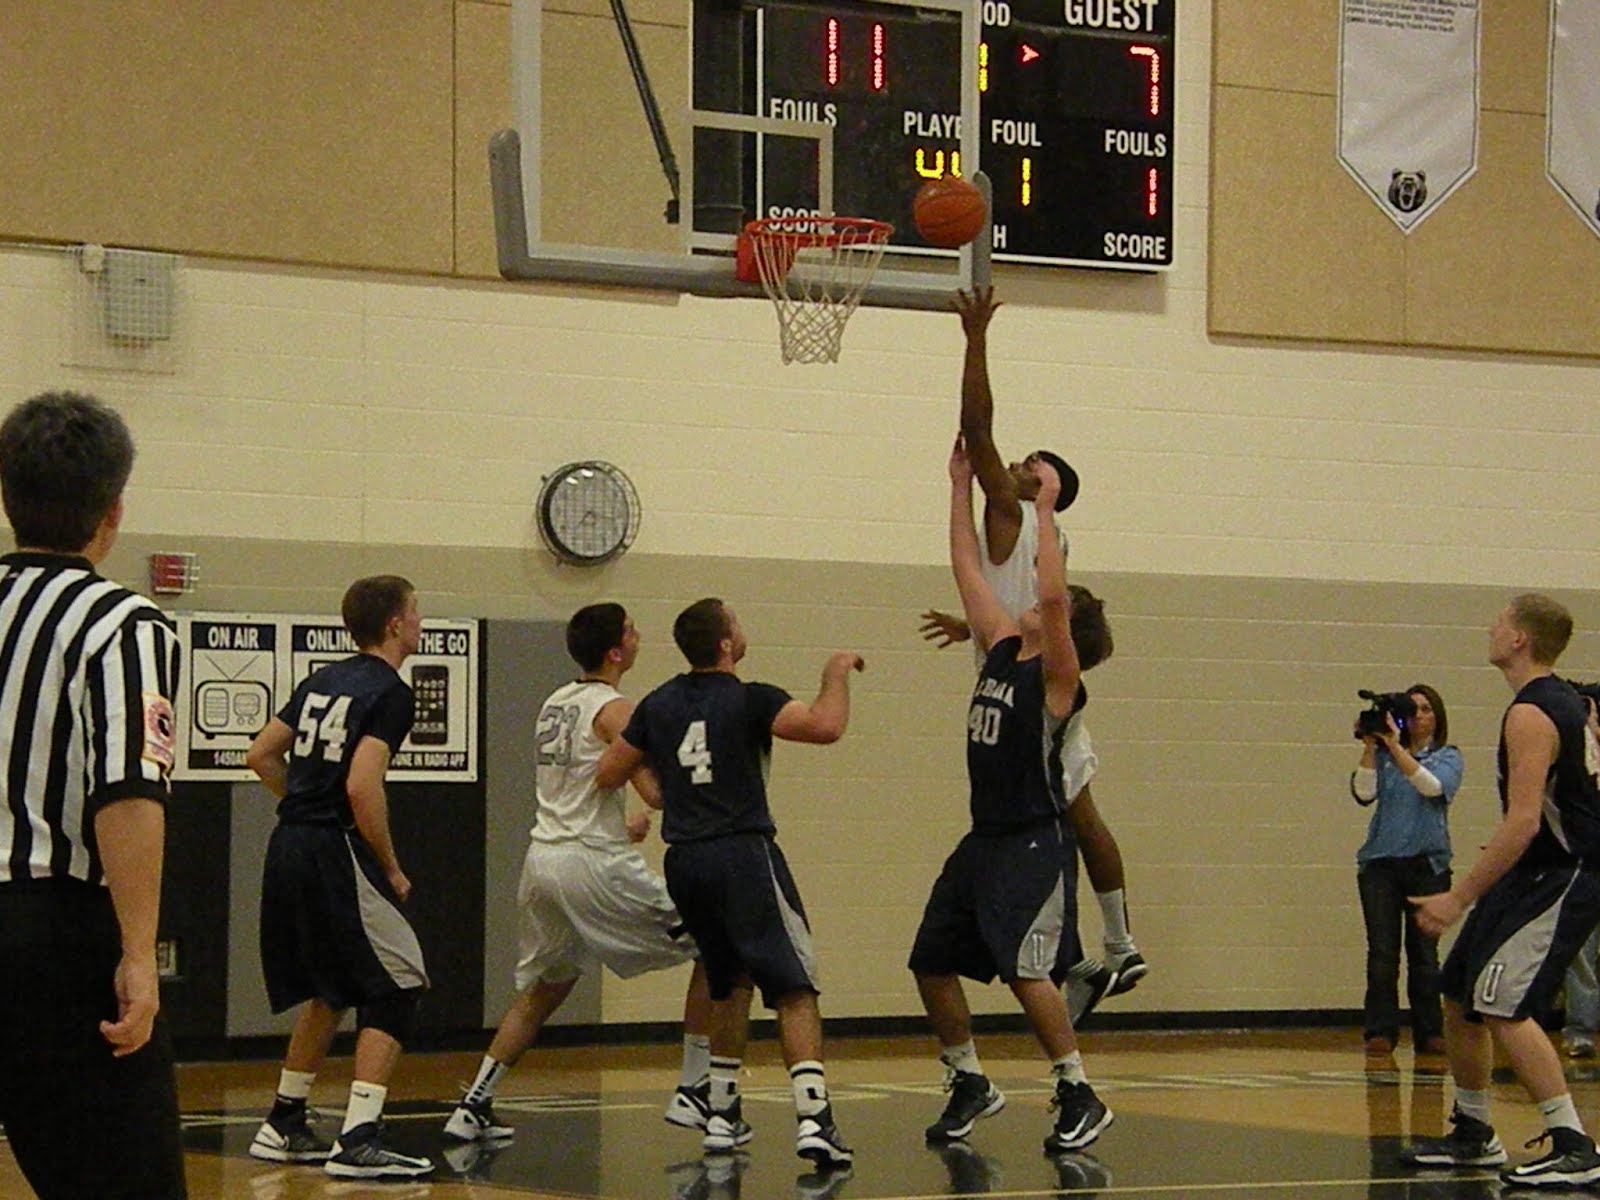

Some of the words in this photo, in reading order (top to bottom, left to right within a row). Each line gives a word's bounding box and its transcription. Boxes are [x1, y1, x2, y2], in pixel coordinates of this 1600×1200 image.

[1064, 0, 1159, 32] GUEST
[1130, 46, 1160, 115] 7
[770, 97, 837, 128] FOULS
[903, 110, 962, 139] PLAYE
[991, 119, 1043, 147] FOUL
[1104, 128, 1168, 158] FOULS
[1103, 231, 1167, 260] SCORE
[207, 625, 230, 648] ON
[233, 626, 260, 649] AIR
[417, 632, 445, 654] THE
[446, 632, 468, 655] GO
[294, 691, 354, 763] 54
[678, 720, 713, 785] 4
